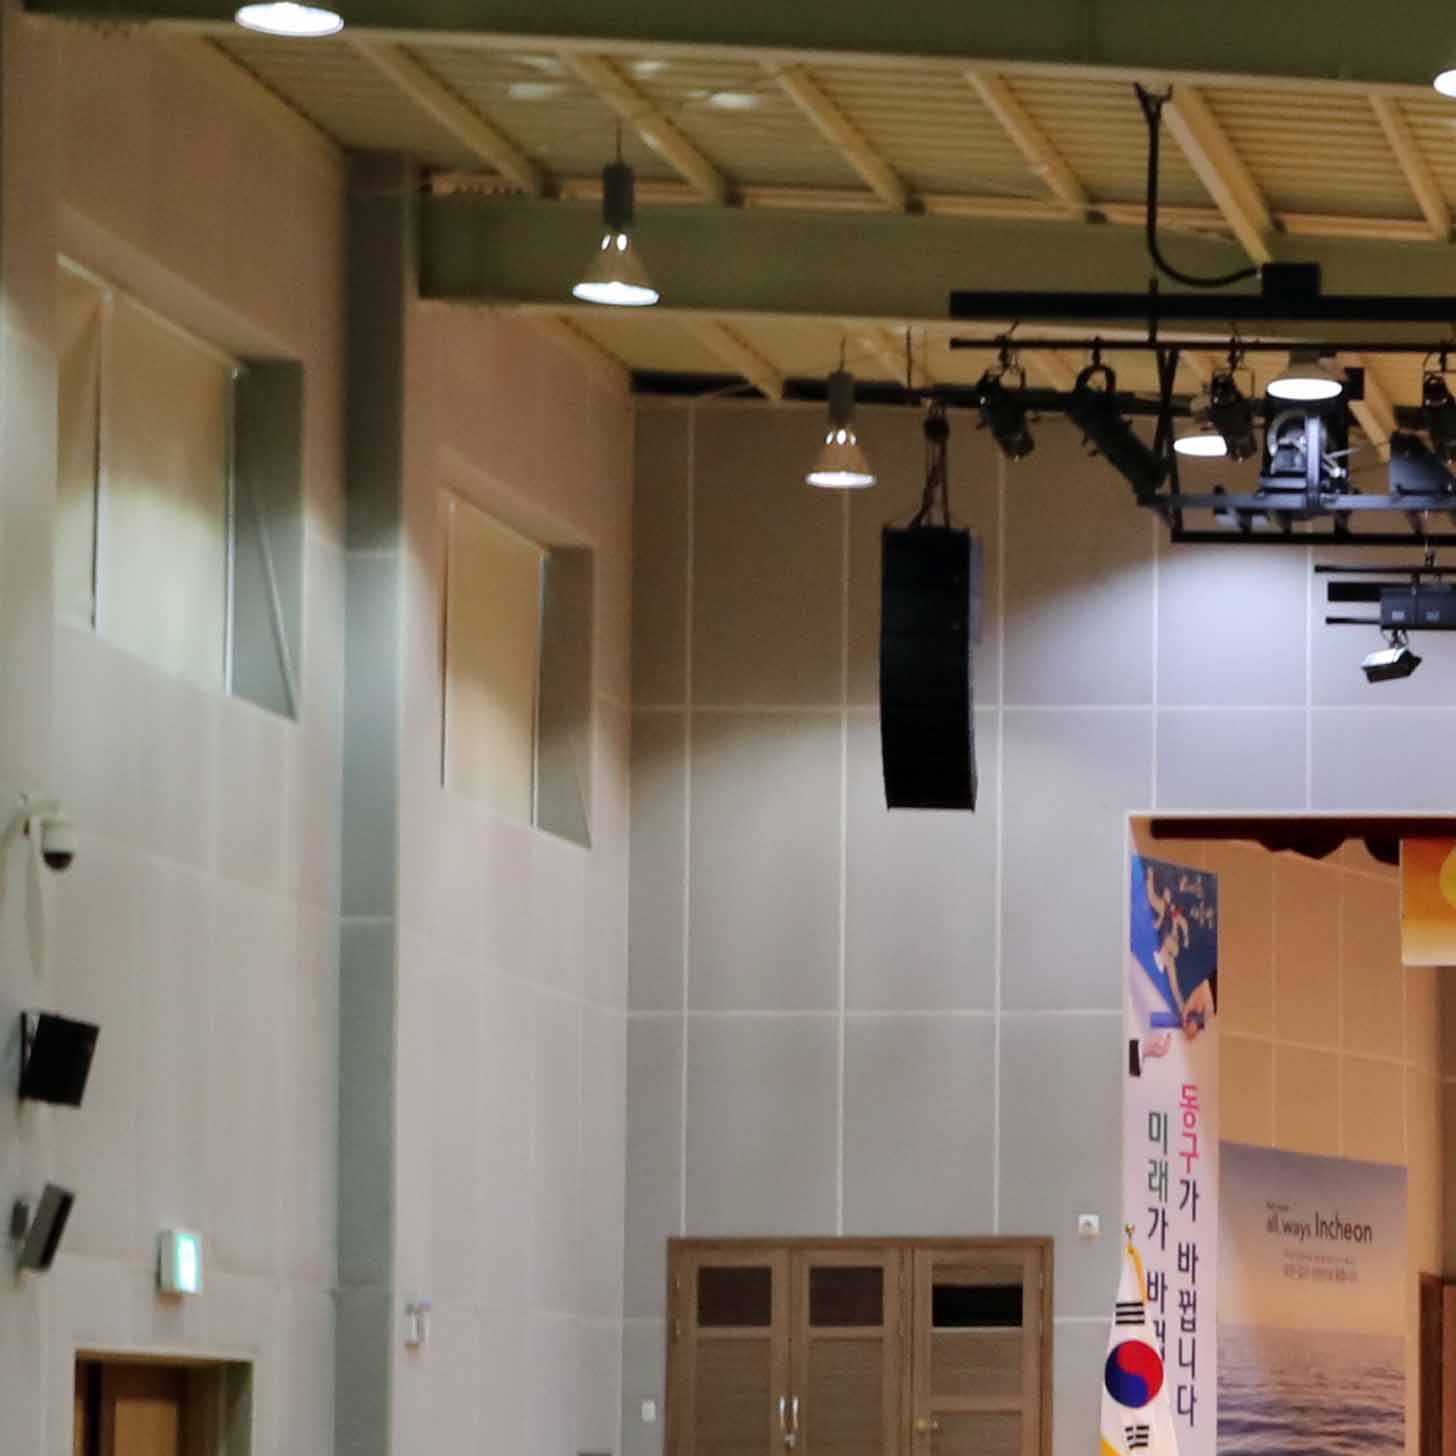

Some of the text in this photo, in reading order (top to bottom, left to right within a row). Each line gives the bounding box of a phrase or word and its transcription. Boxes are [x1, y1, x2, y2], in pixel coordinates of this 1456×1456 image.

[1146, 1110, 1170, 1251] 미래가
[1177, 1084, 1200, 1224] 동구가
[1314, 1209, 1374, 1246] Incheon
